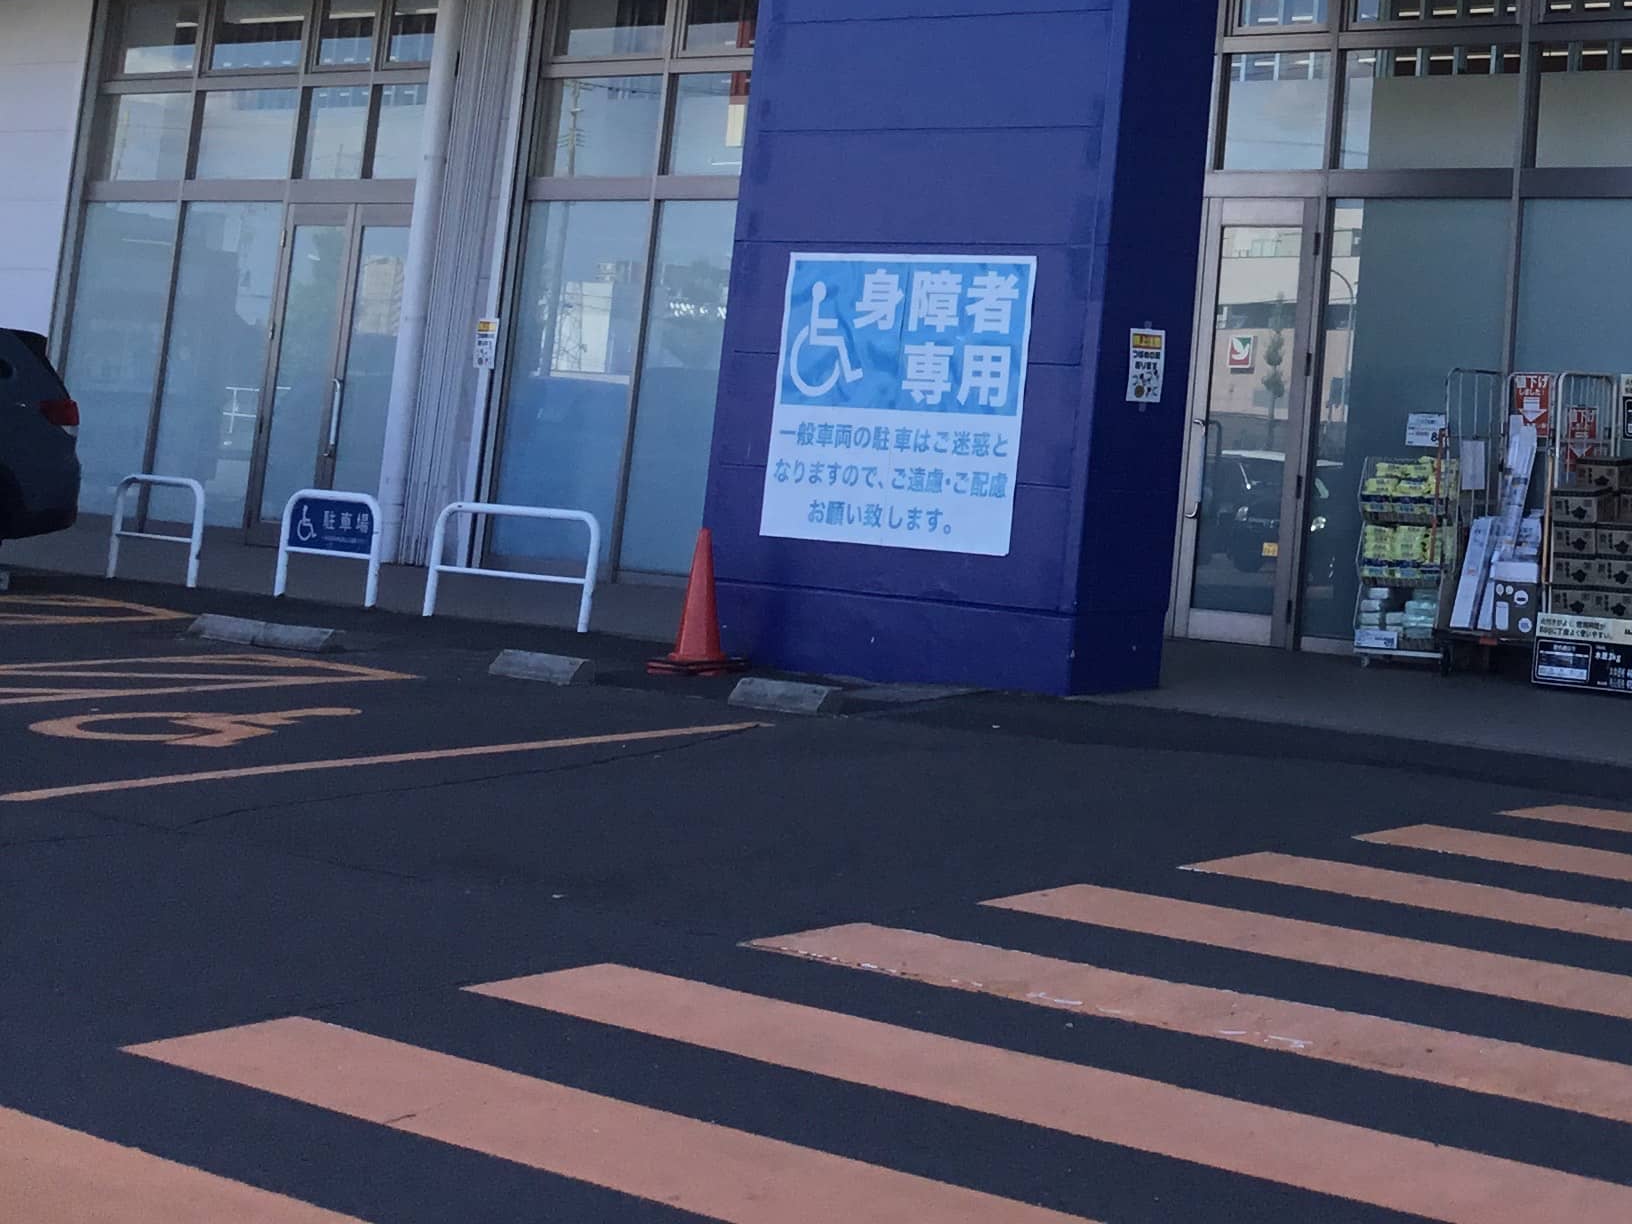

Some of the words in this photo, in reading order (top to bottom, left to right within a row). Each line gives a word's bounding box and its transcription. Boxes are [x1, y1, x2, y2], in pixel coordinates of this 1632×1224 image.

[852, 267, 1020, 335] 身障者
[901, 341, 1012, 407] 専用
[779, 421, 1010, 458] 一般車両の駐車はご迷惑と
[772, 457, 1007, 498] なりますので、ご遠慮・ご配慮
[322, 510, 369, 534] 駐車場
[807, 499, 952, 536] お願い致します。
